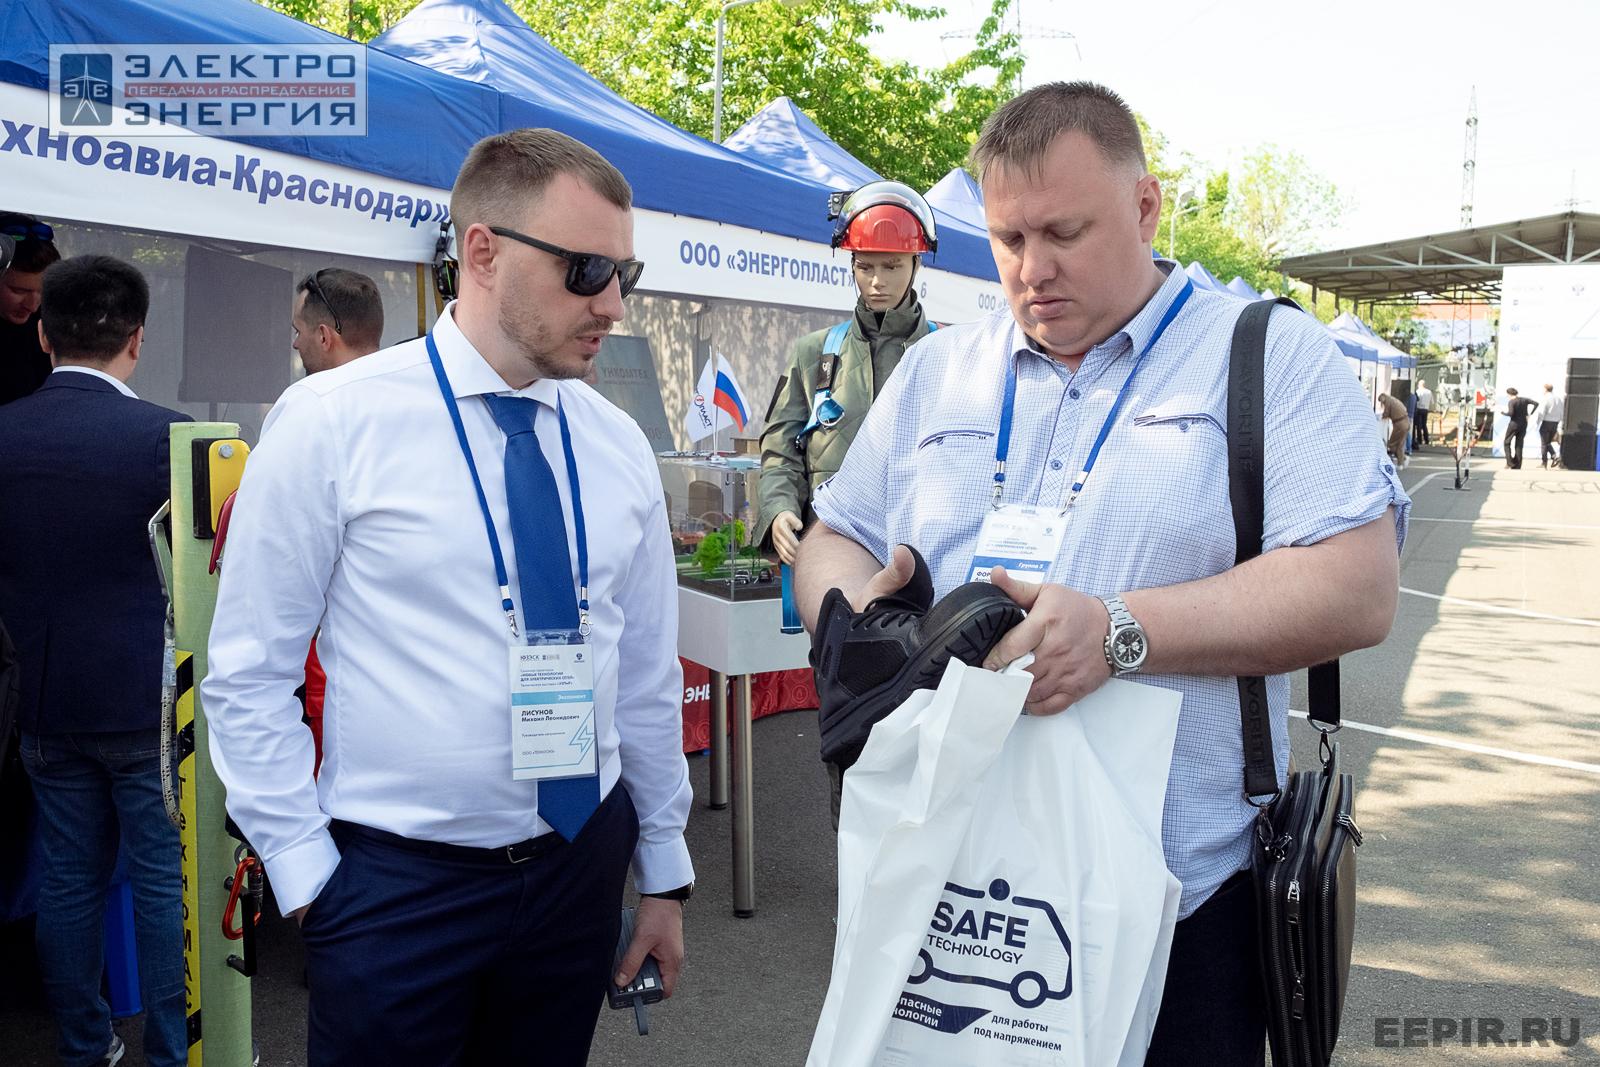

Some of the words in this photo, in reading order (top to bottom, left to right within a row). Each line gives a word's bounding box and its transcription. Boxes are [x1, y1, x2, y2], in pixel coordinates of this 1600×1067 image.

[680, 239, 720, 269] ООО
[521, 709, 554, 717] ЛИСУНОВ
[930, 901, 1029, 950] SAFE
[927, 934, 1023, 965] TECHNOLOGY
[991, 1014, 1010, 1025] для
[1011, 1016, 1049, 1033] работы
[973, 1025, 993, 1038] под
[993, 1030, 1062, 1052] напряжением
